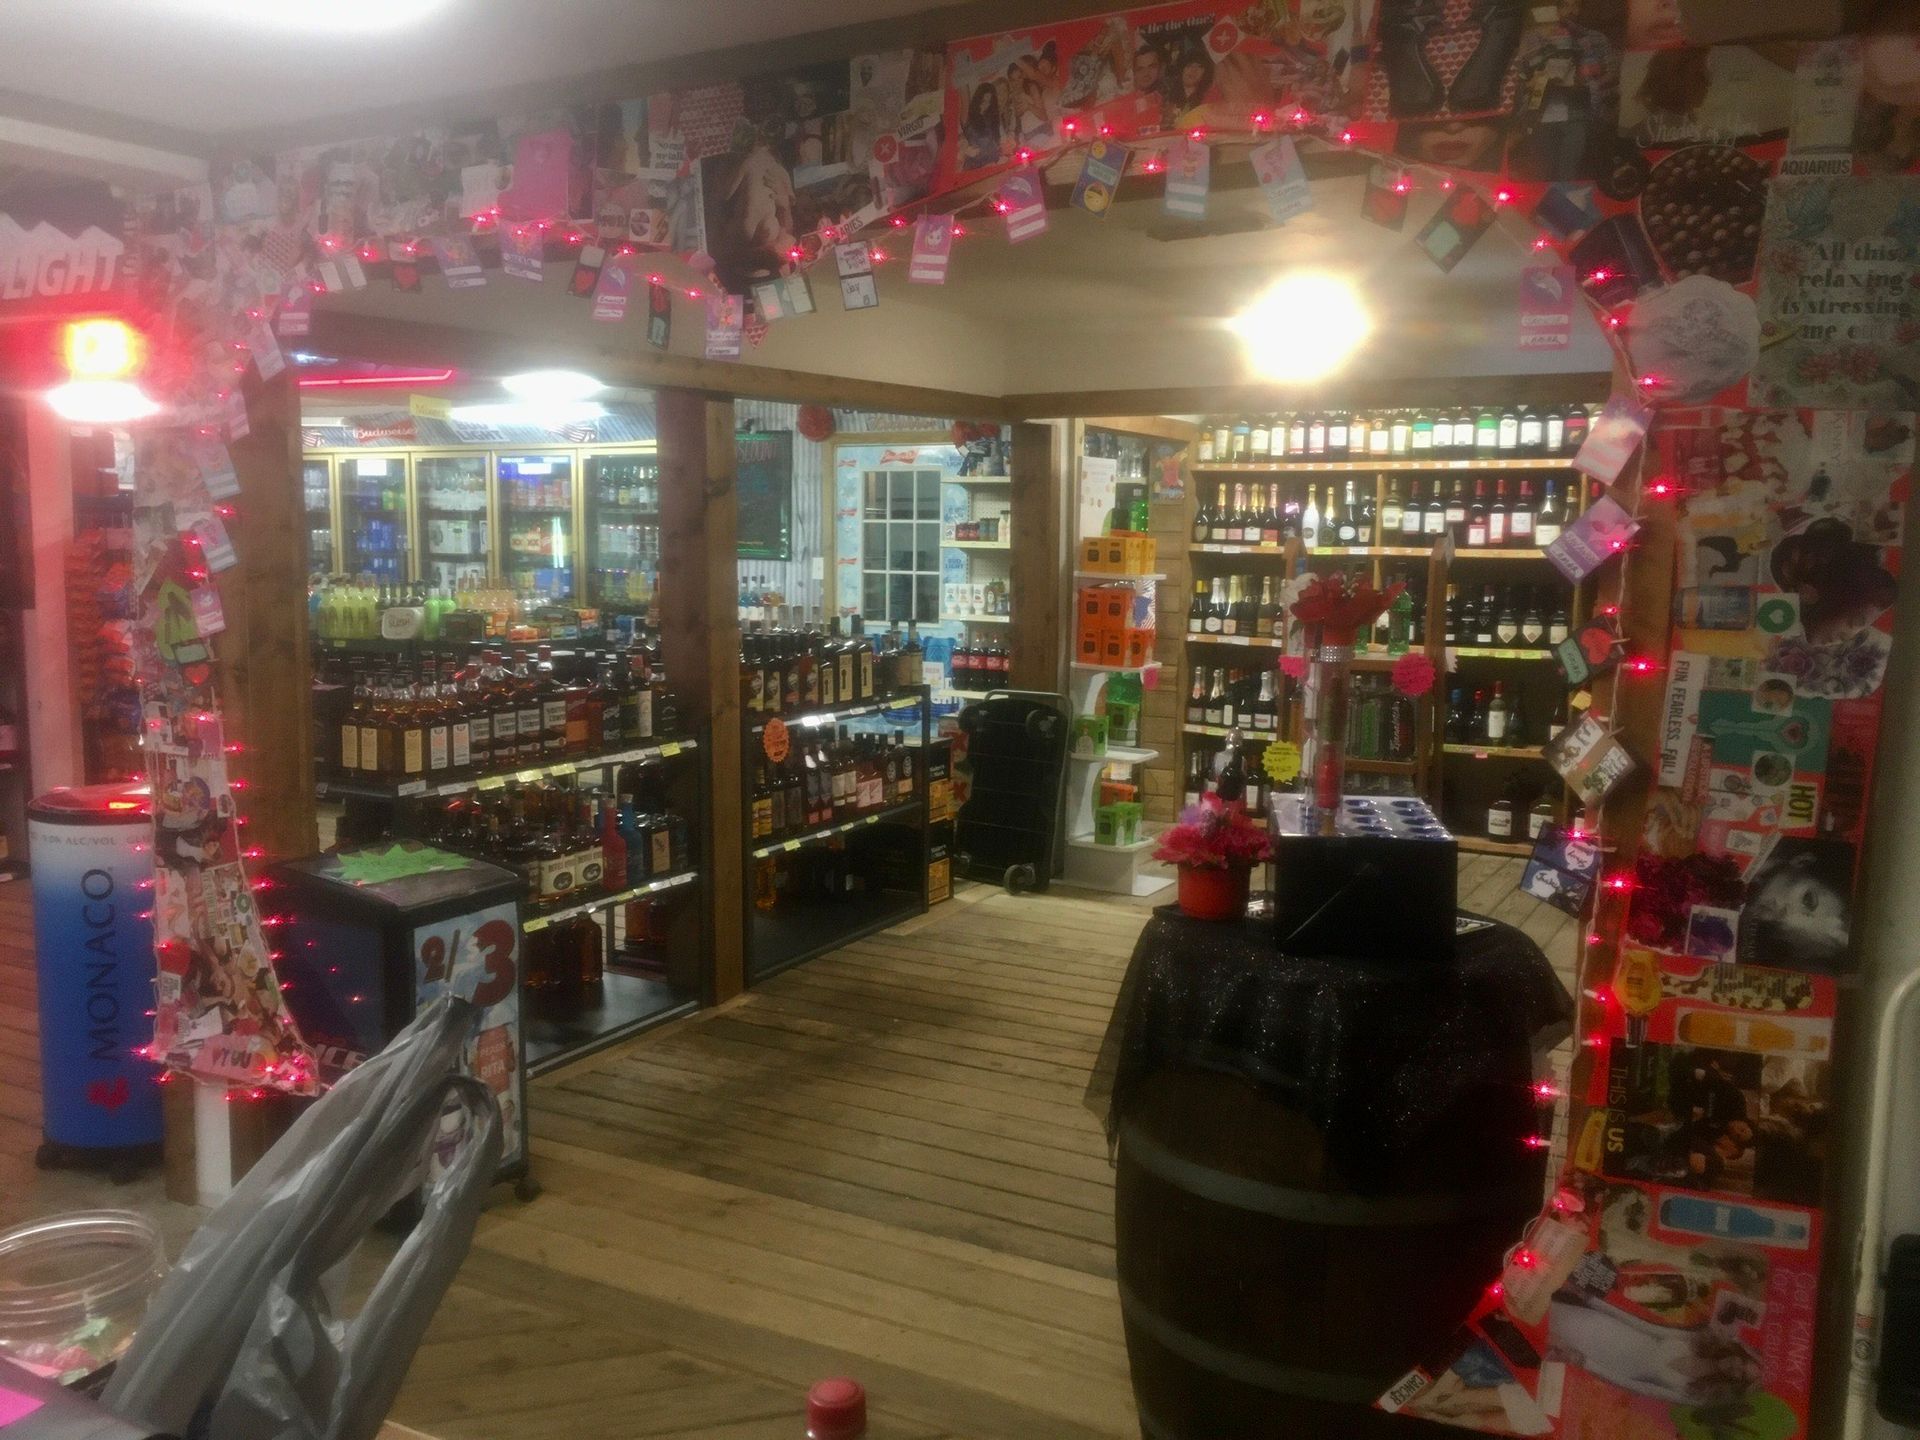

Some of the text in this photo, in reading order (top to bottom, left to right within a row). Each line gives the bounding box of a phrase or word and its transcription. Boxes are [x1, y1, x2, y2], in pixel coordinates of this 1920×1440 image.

[897, 117, 925, 138] VIRGO
[1781, 158, 1850, 175] AQUARIUS
[838, 216, 864, 239] ARIES
[1816, 241, 1845, 261] All
[2, 232, 124, 300] LIGHT
[1799, 268, 1904, 297] relaxing
[1782, 295, 1914, 320] is stressing
[1800, 324, 1838, 340] me
[352, 425, 418, 440] Budweiser
[457, 430, 505, 441] LIGHT
[1671, 660, 1690, 685] FUN,
[1787, 784, 1816, 823] HOT
[65, 836, 116, 846] ALC/VOL
[81, 868, 122, 1062] MONACO
[1606, 1065, 1628, 1154] THIS IS US
[1762, 1267, 1797, 1385] for a cause
[1785, 1272, 1817, 1393] Get KINKY
[1389, 1374, 1425, 1406] CANCER
